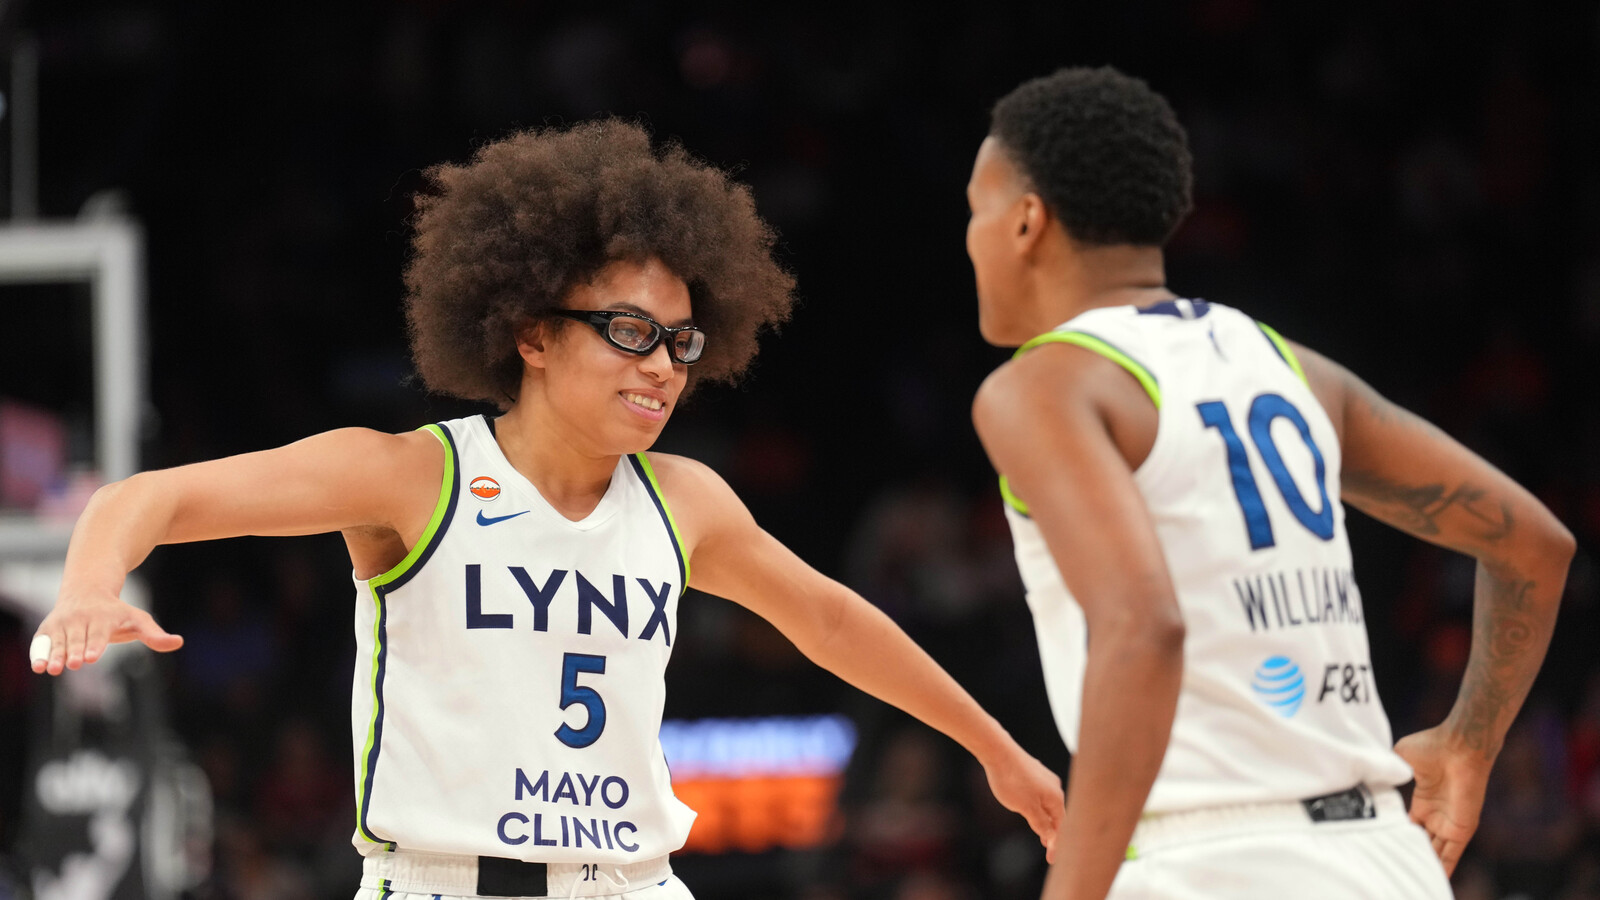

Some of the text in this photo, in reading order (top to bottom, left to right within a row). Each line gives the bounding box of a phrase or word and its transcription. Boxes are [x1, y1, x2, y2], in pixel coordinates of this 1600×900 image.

[1195, 393, 1334, 550] 10
[465, 564, 672, 647] LYNX
[553, 652, 607, 749] 5
[514, 767, 630, 810] MAYO
[496, 811, 640, 852] CLINIC
